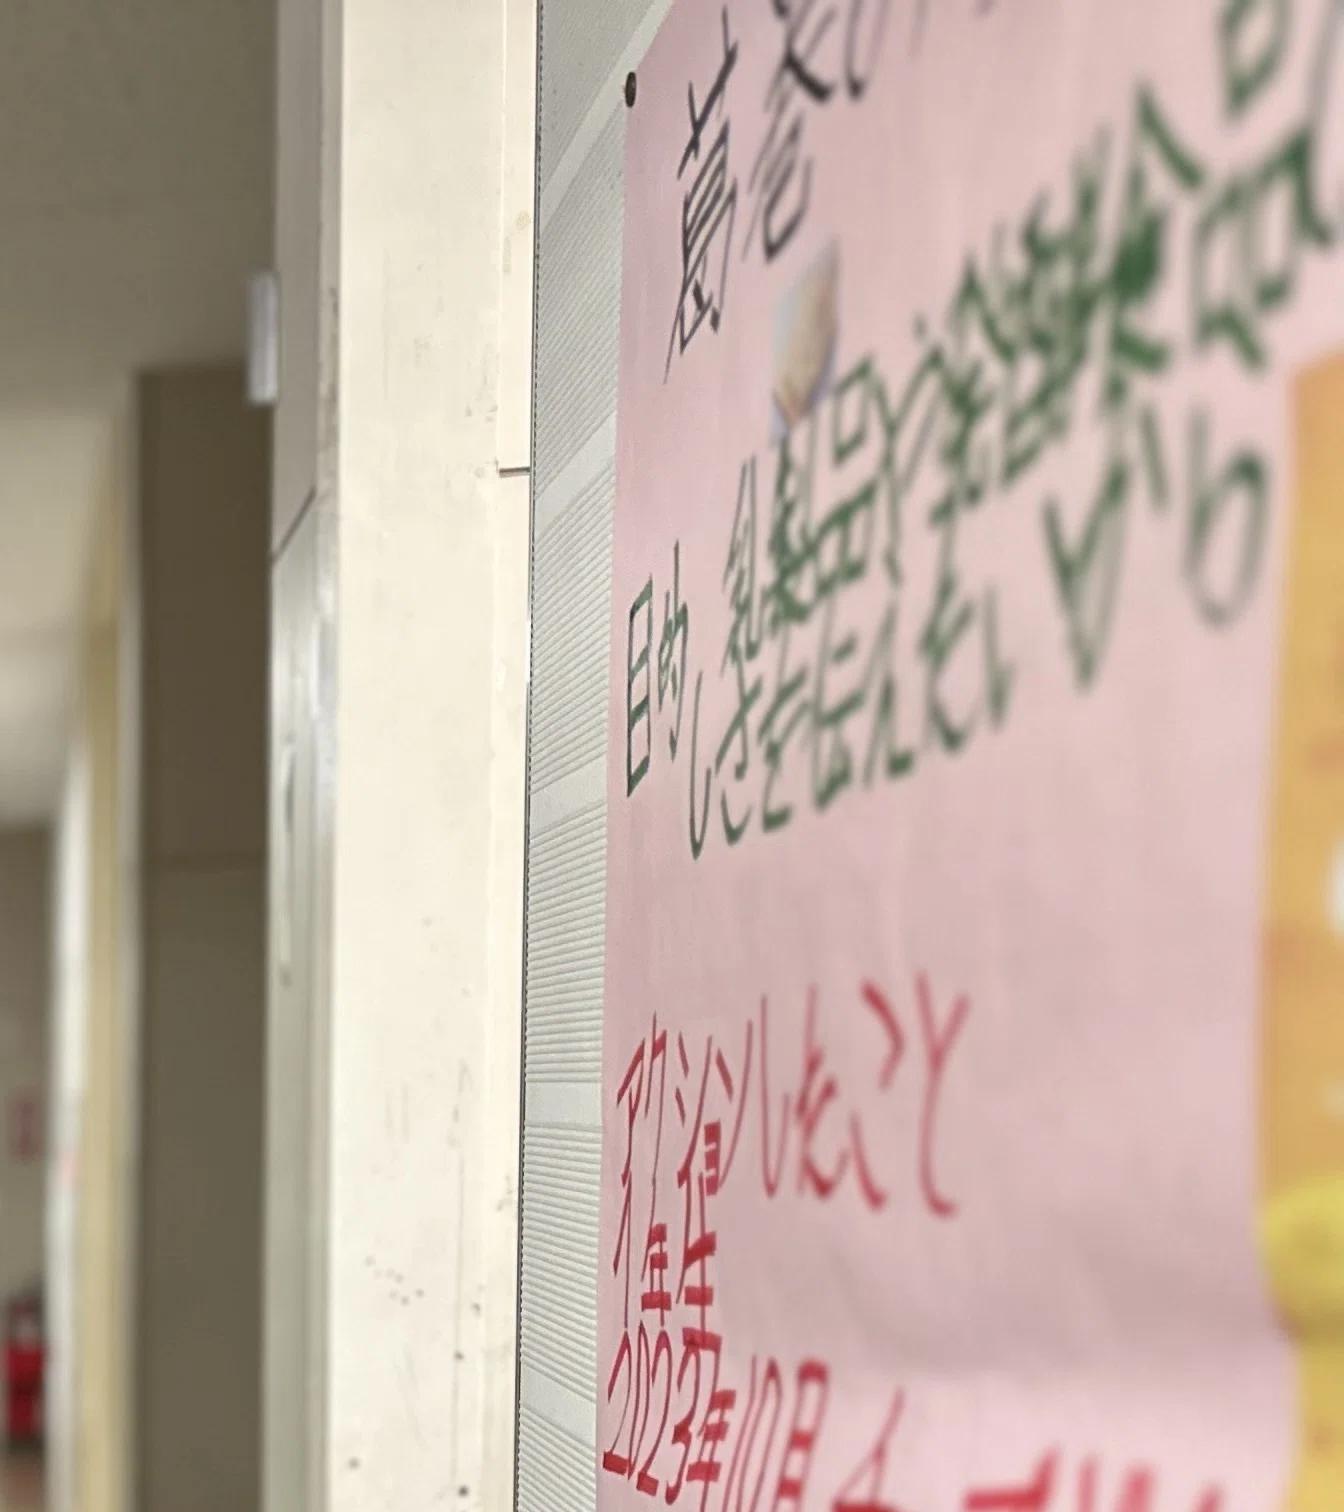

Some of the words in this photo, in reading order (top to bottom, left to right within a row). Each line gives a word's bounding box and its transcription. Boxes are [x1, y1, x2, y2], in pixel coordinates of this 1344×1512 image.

[626, 538, 689, 798] 目的
[615, 968, 969, 1216] アクションしたこと
